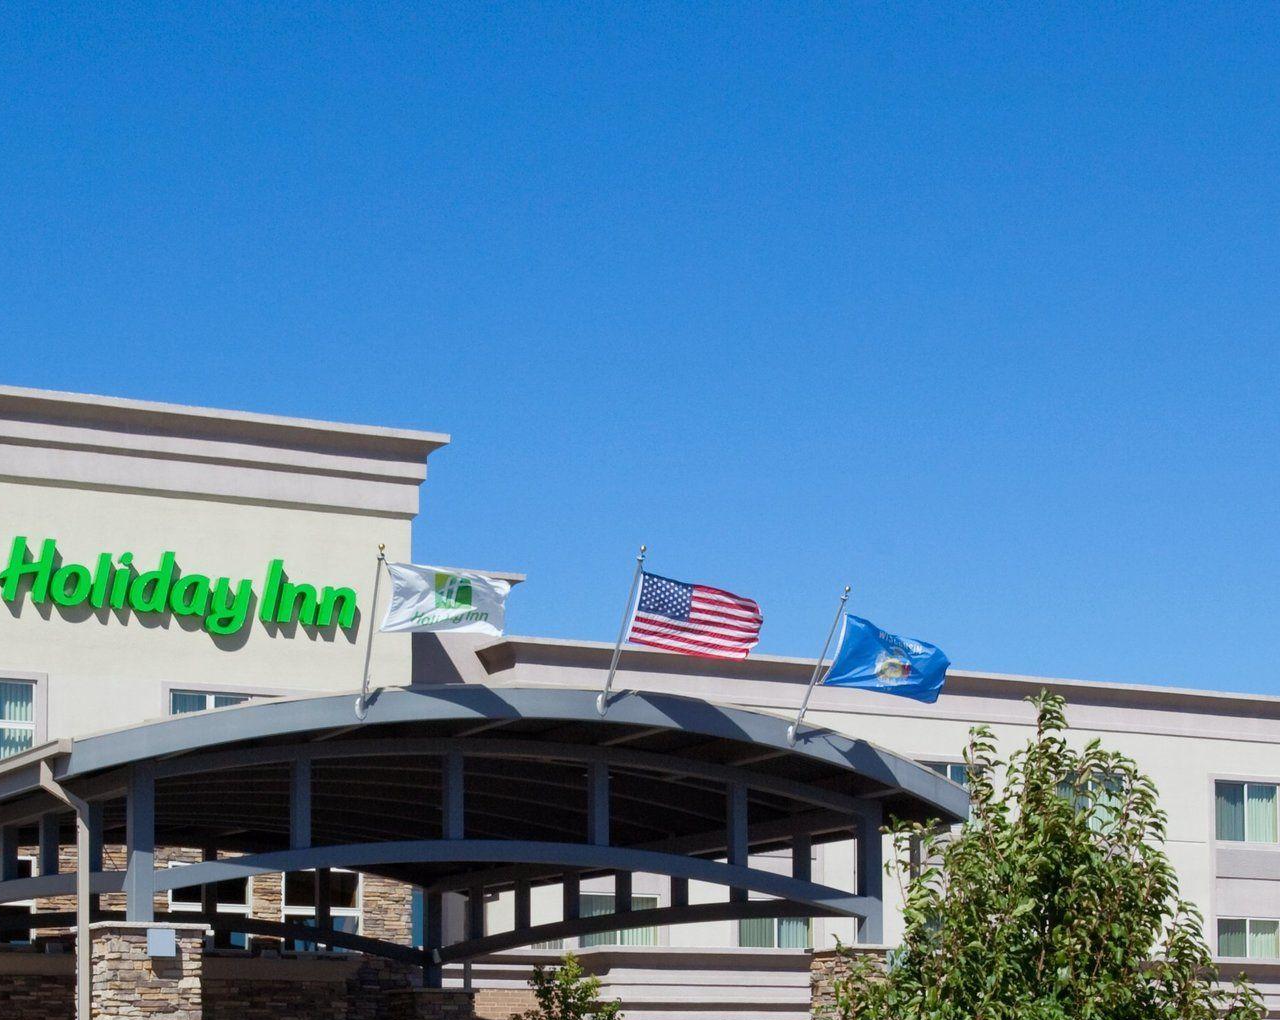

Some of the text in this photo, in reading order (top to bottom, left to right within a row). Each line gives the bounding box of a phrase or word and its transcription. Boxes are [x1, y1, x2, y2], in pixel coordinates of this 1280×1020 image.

[259, 558, 358, 630] Inn
[411, 610, 489, 625] Holiy Inn
